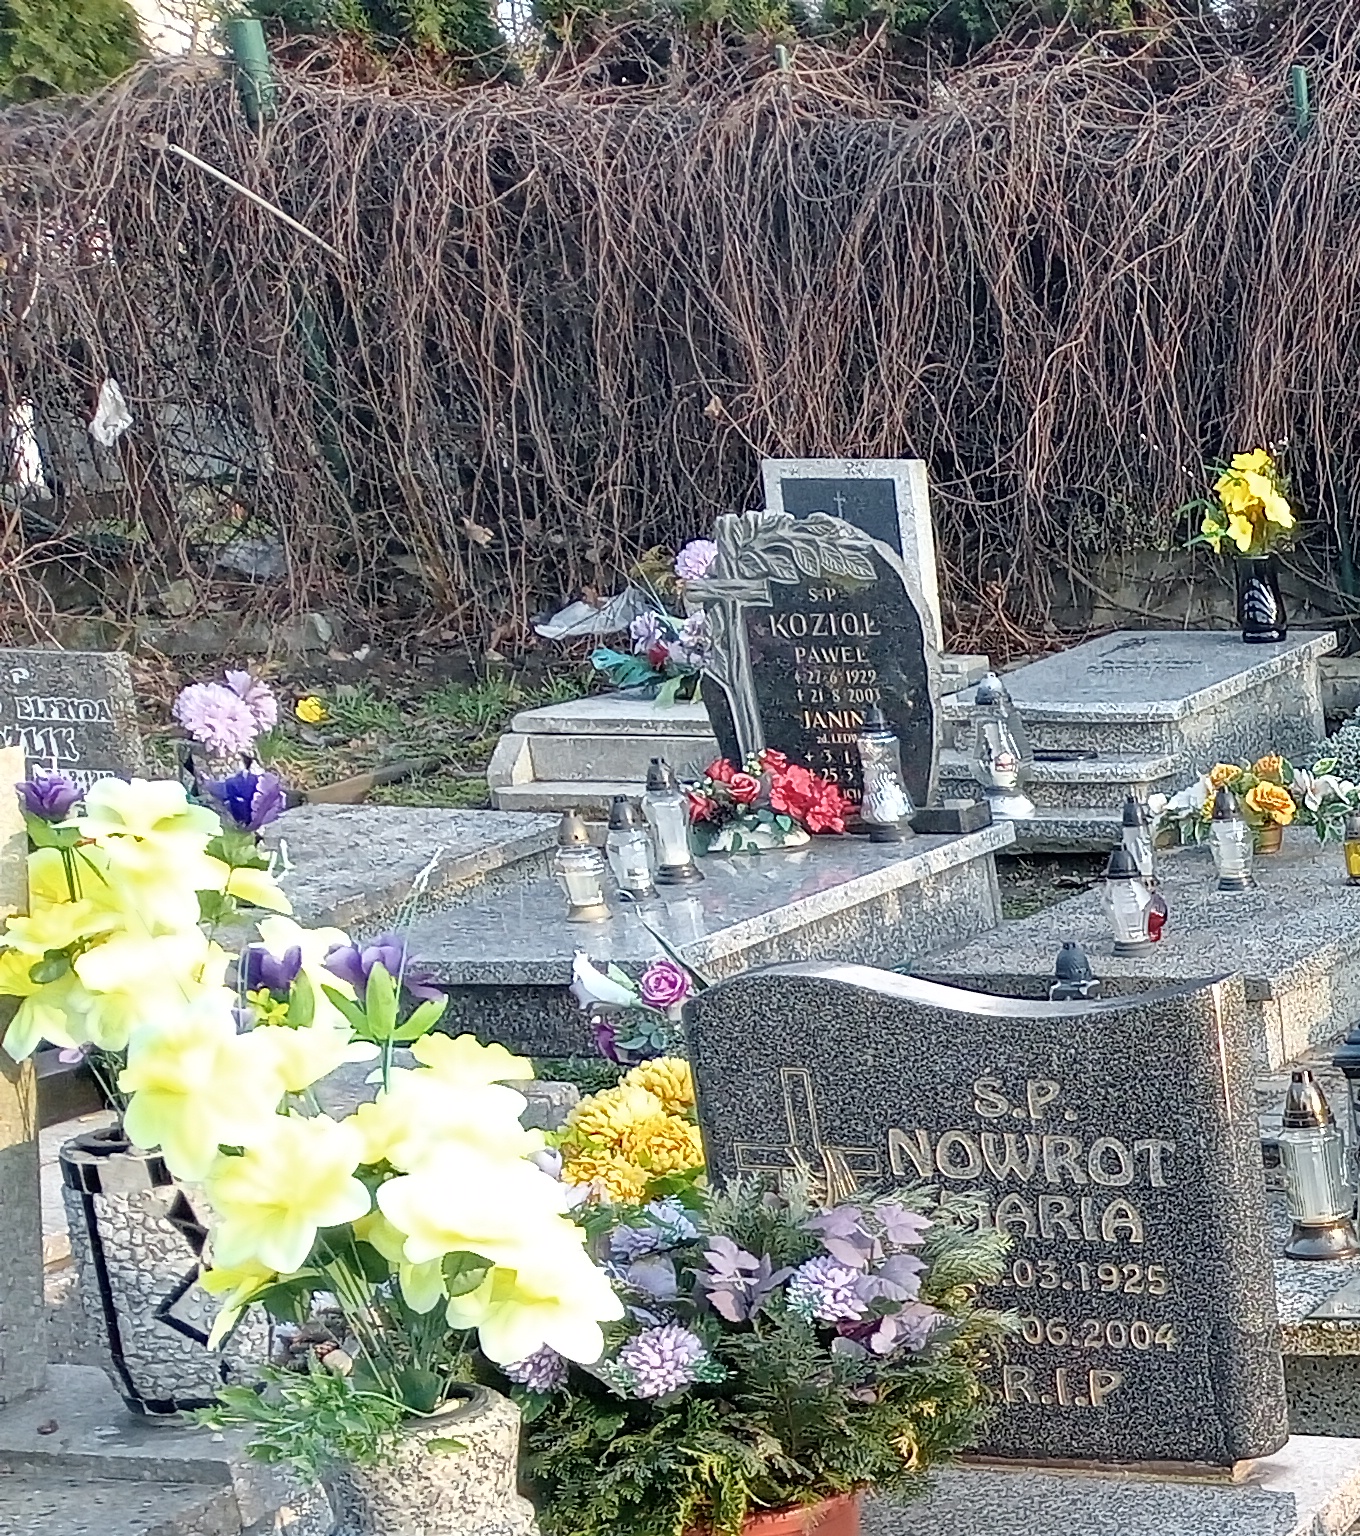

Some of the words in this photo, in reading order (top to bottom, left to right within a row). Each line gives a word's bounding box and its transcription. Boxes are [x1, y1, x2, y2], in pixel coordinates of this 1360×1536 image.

[795, 646, 870, 664] PAWEŁ
[15, 696, 112, 722] ELFRYDA
[802, 710, 865, 731] JANIN
[973, 1067, 1079, 1121] Ś.P.
[887, 1127, 1177, 1188] NOWROT
